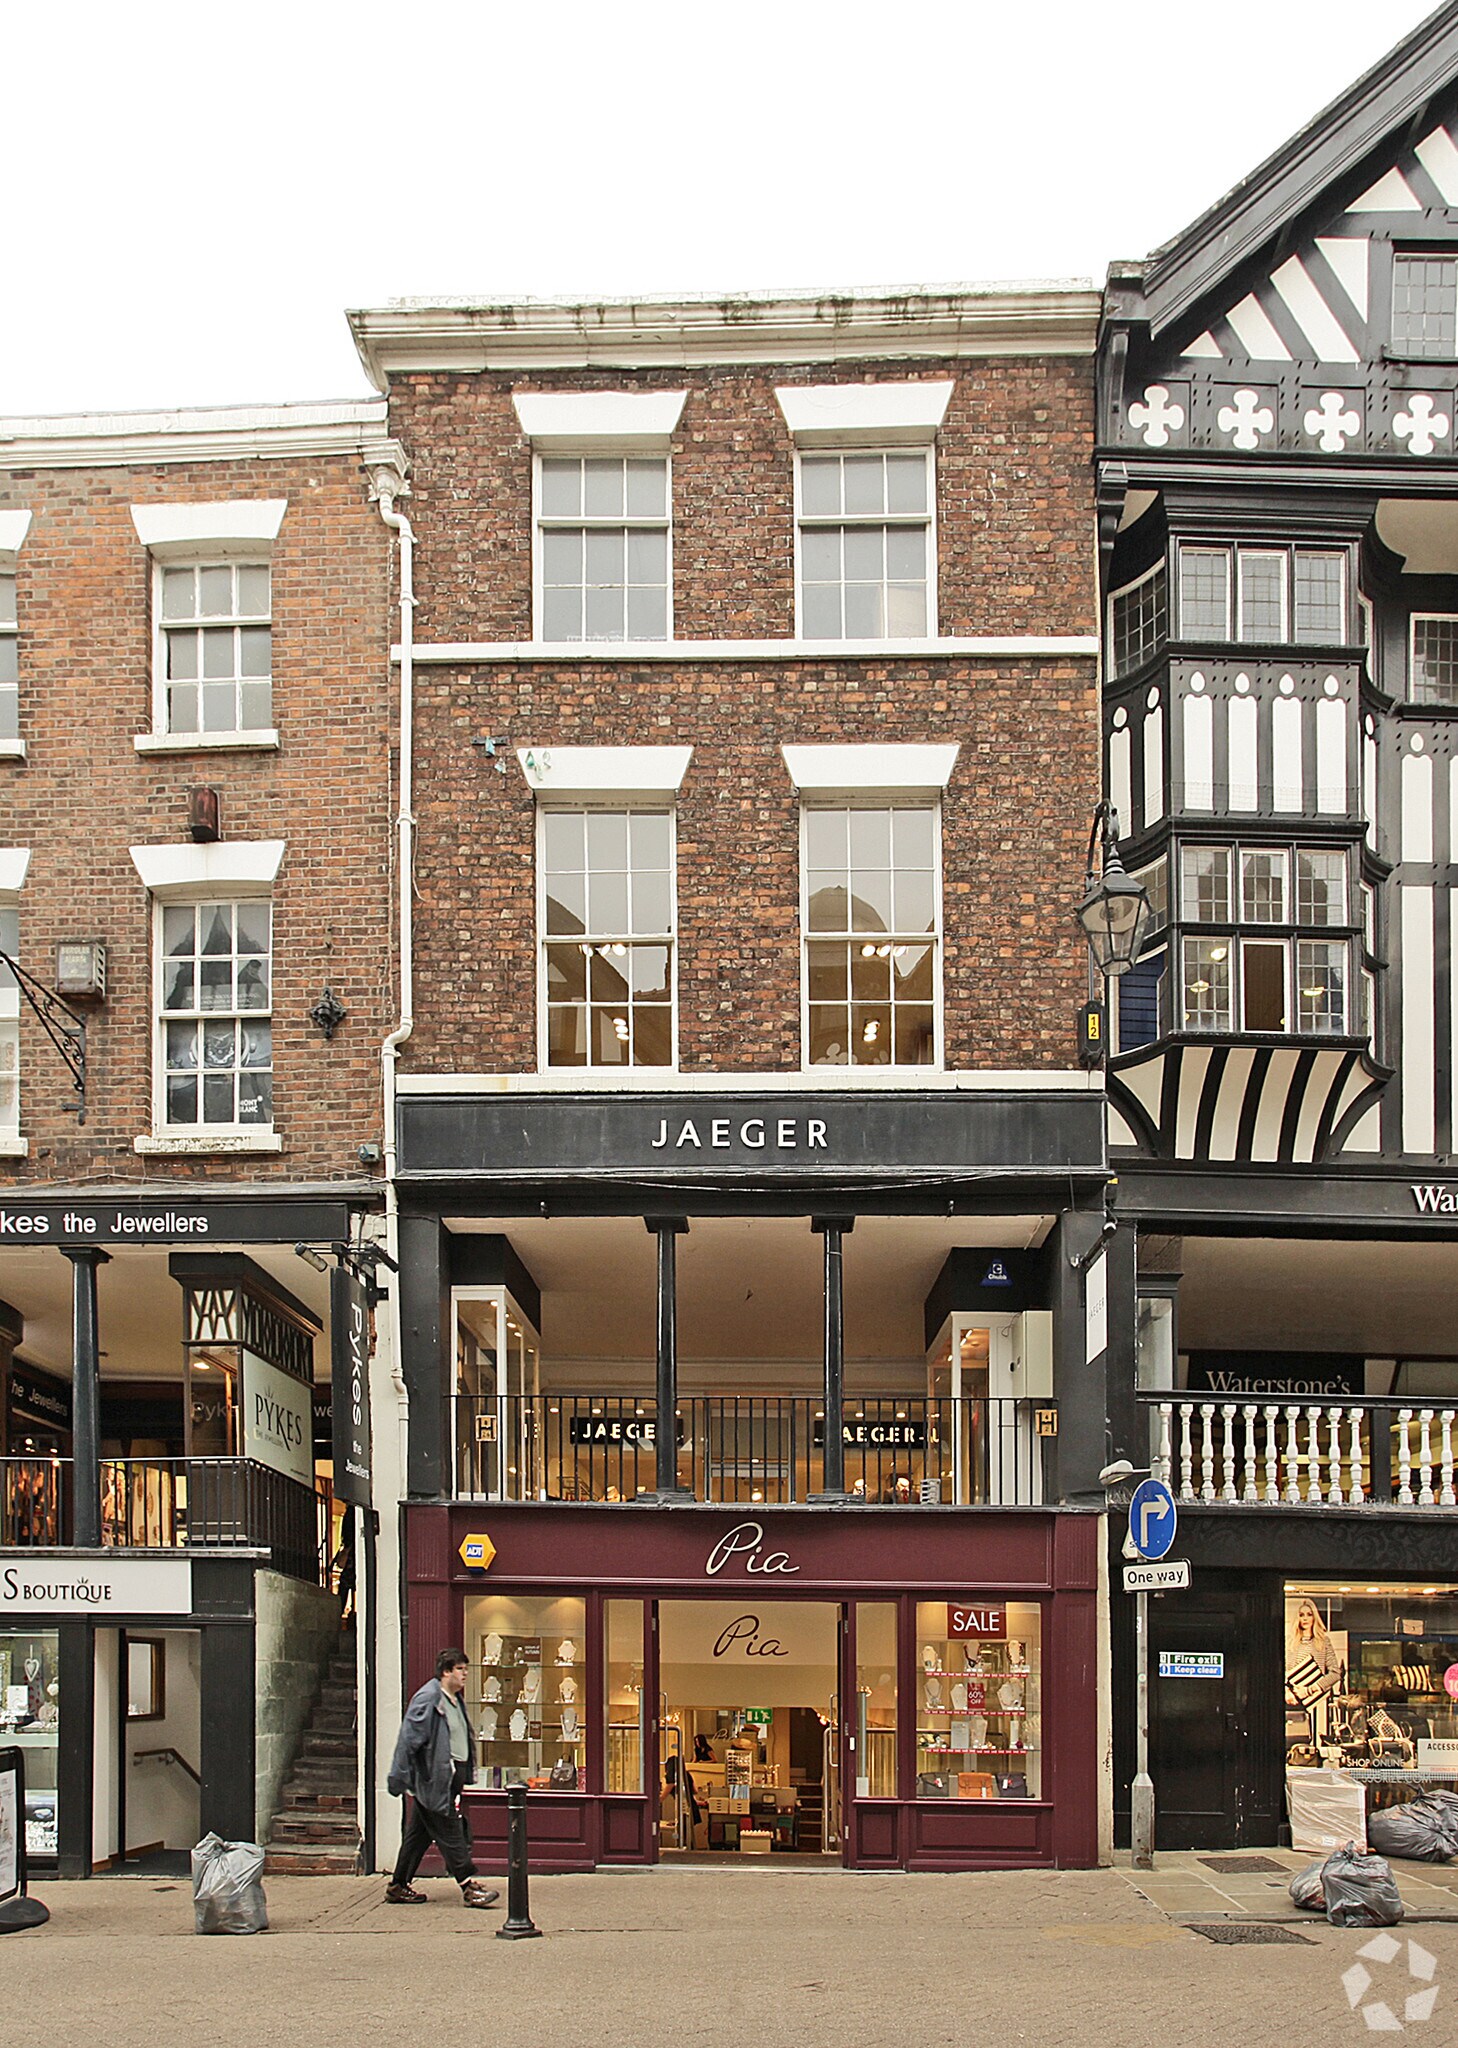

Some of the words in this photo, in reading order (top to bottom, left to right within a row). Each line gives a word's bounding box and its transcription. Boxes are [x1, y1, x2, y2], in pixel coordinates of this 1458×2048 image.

[651, 1118, 829, 1149] JAEGER
[63, 1213, 97, 1234] the
[110, 1212, 209, 1234] Jewellers
[348, 1302, 363, 1427] Pykes
[255, 1393, 302, 1451] PYKES
[582, 1422, 656, 1439] JAEGE
[842, 1426, 915, 1442] AEGER
[352, 1440, 362, 1455] the
[345, 1459, 370, 1480] Jewellers
[466, 1547, 483, 1557] ADT
[705, 1521, 800, 1575] Pia
[1127, 1571, 1154, 1584] One
[1157, 1570, 1183, 1583] way
[23, 1584, 111, 1604] BOUTIQUE
[953, 1611, 1000, 1632] SALE
[713, 1614, 789, 1657] Pia
[1174, 1655, 1196, 1664] Fire
[1197, 1655, 1218, 1665] exit
[1174, 1665, 1196, 1674] Keep
[1197, 1666, 1218, 1674] clear
[1346, 1758, 1371, 1767] SHOP
[1372, 1758, 1405, 1768] ONLINE
